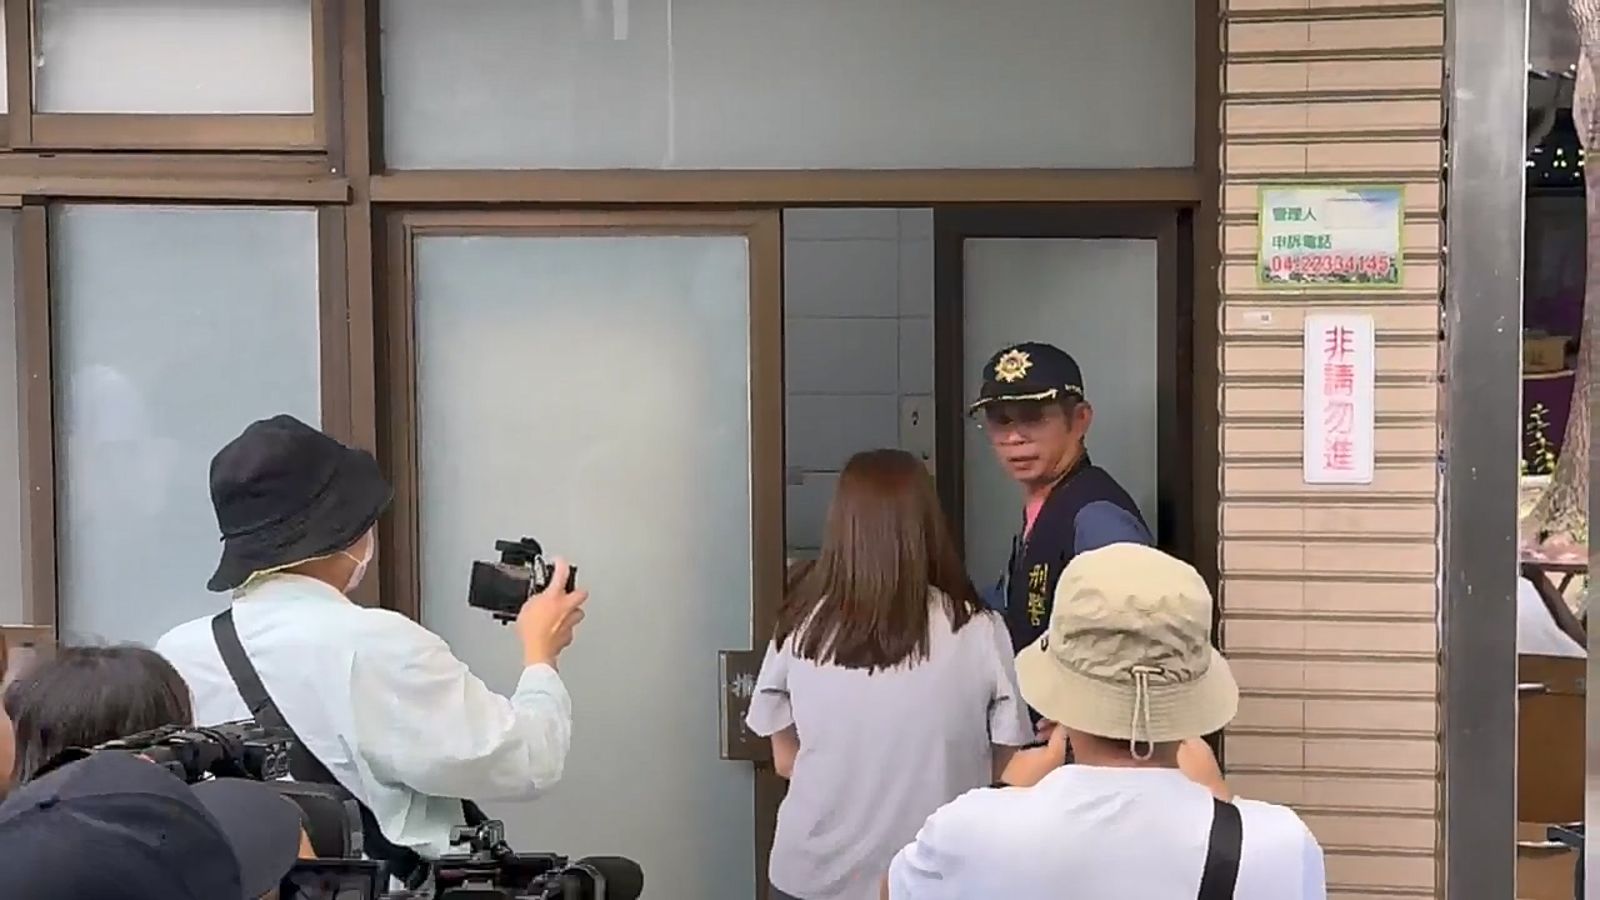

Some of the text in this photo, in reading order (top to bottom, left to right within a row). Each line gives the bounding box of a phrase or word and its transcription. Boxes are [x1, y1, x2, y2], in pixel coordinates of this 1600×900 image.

[1272, 234, 1332, 250] 申訴電話
[1323, 325, 1355, 470] 非請勿進
